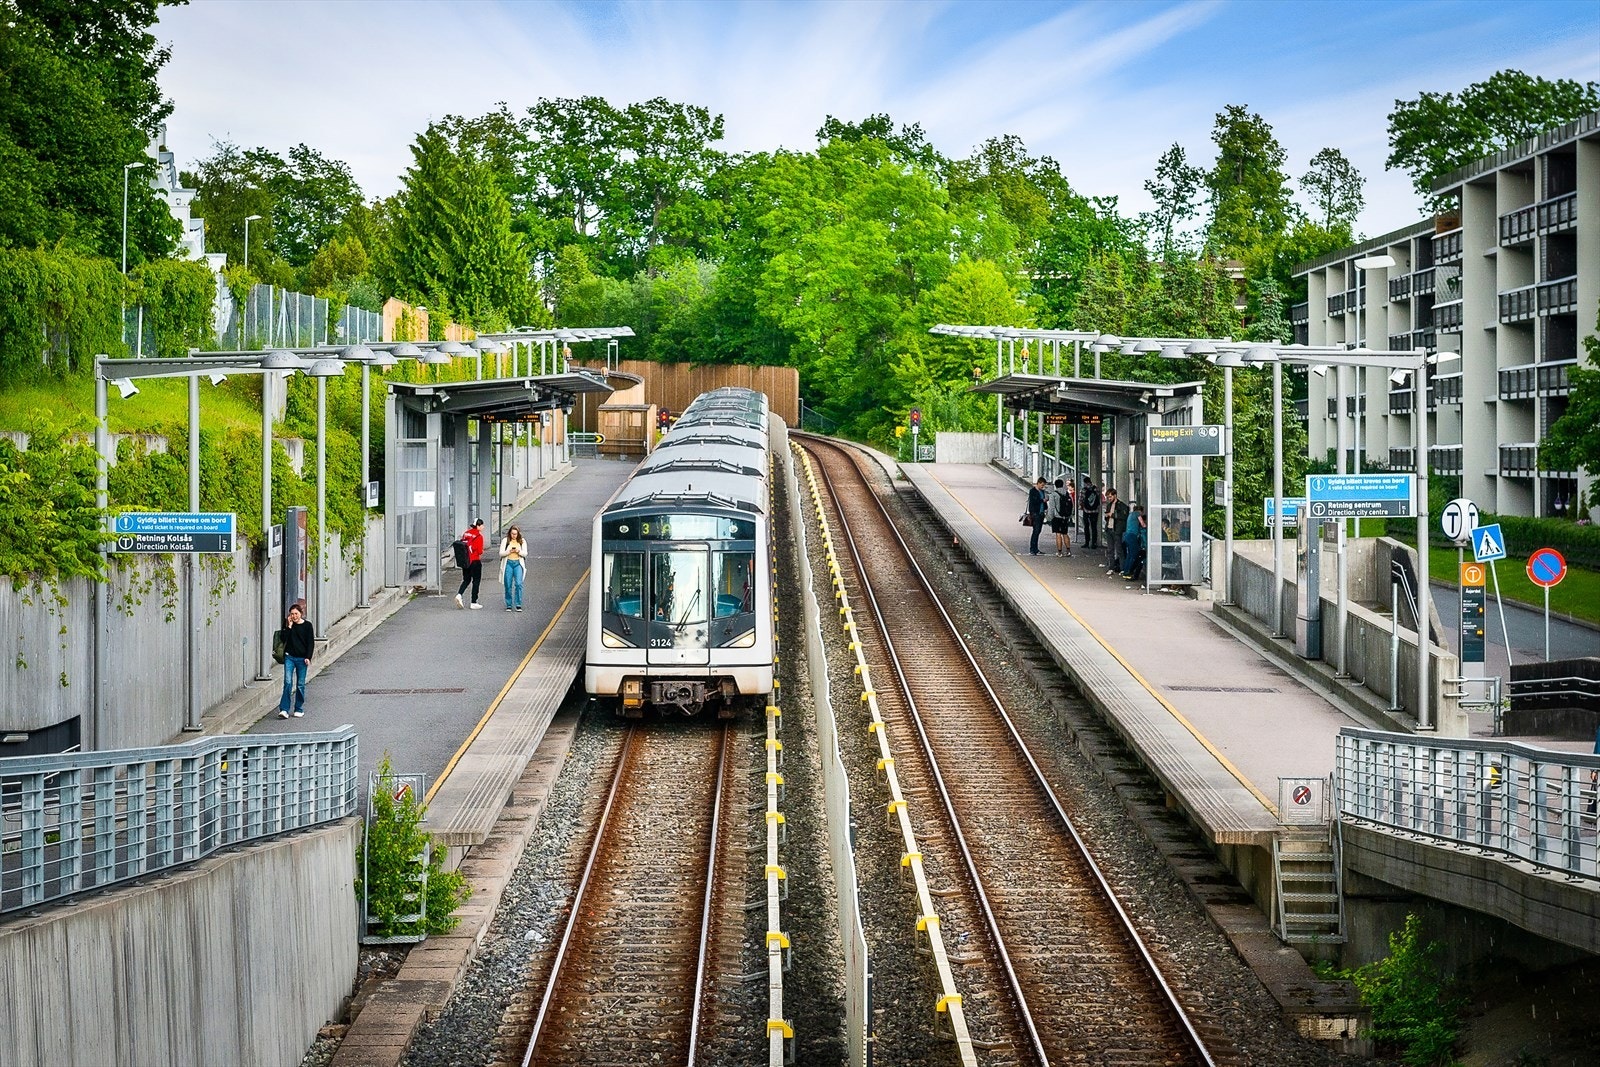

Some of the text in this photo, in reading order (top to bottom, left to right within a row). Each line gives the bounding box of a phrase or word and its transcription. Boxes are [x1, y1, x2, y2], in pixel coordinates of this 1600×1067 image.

[1152, 428, 1194, 438] Utgang Exit
[1356, 509, 1368, 517] city
[1447, 512, 1458, 533] T
[1469, 512, 1475, 529] T
[642, 523, 649, 534] 3
[650, 638, 672, 647] 3124
